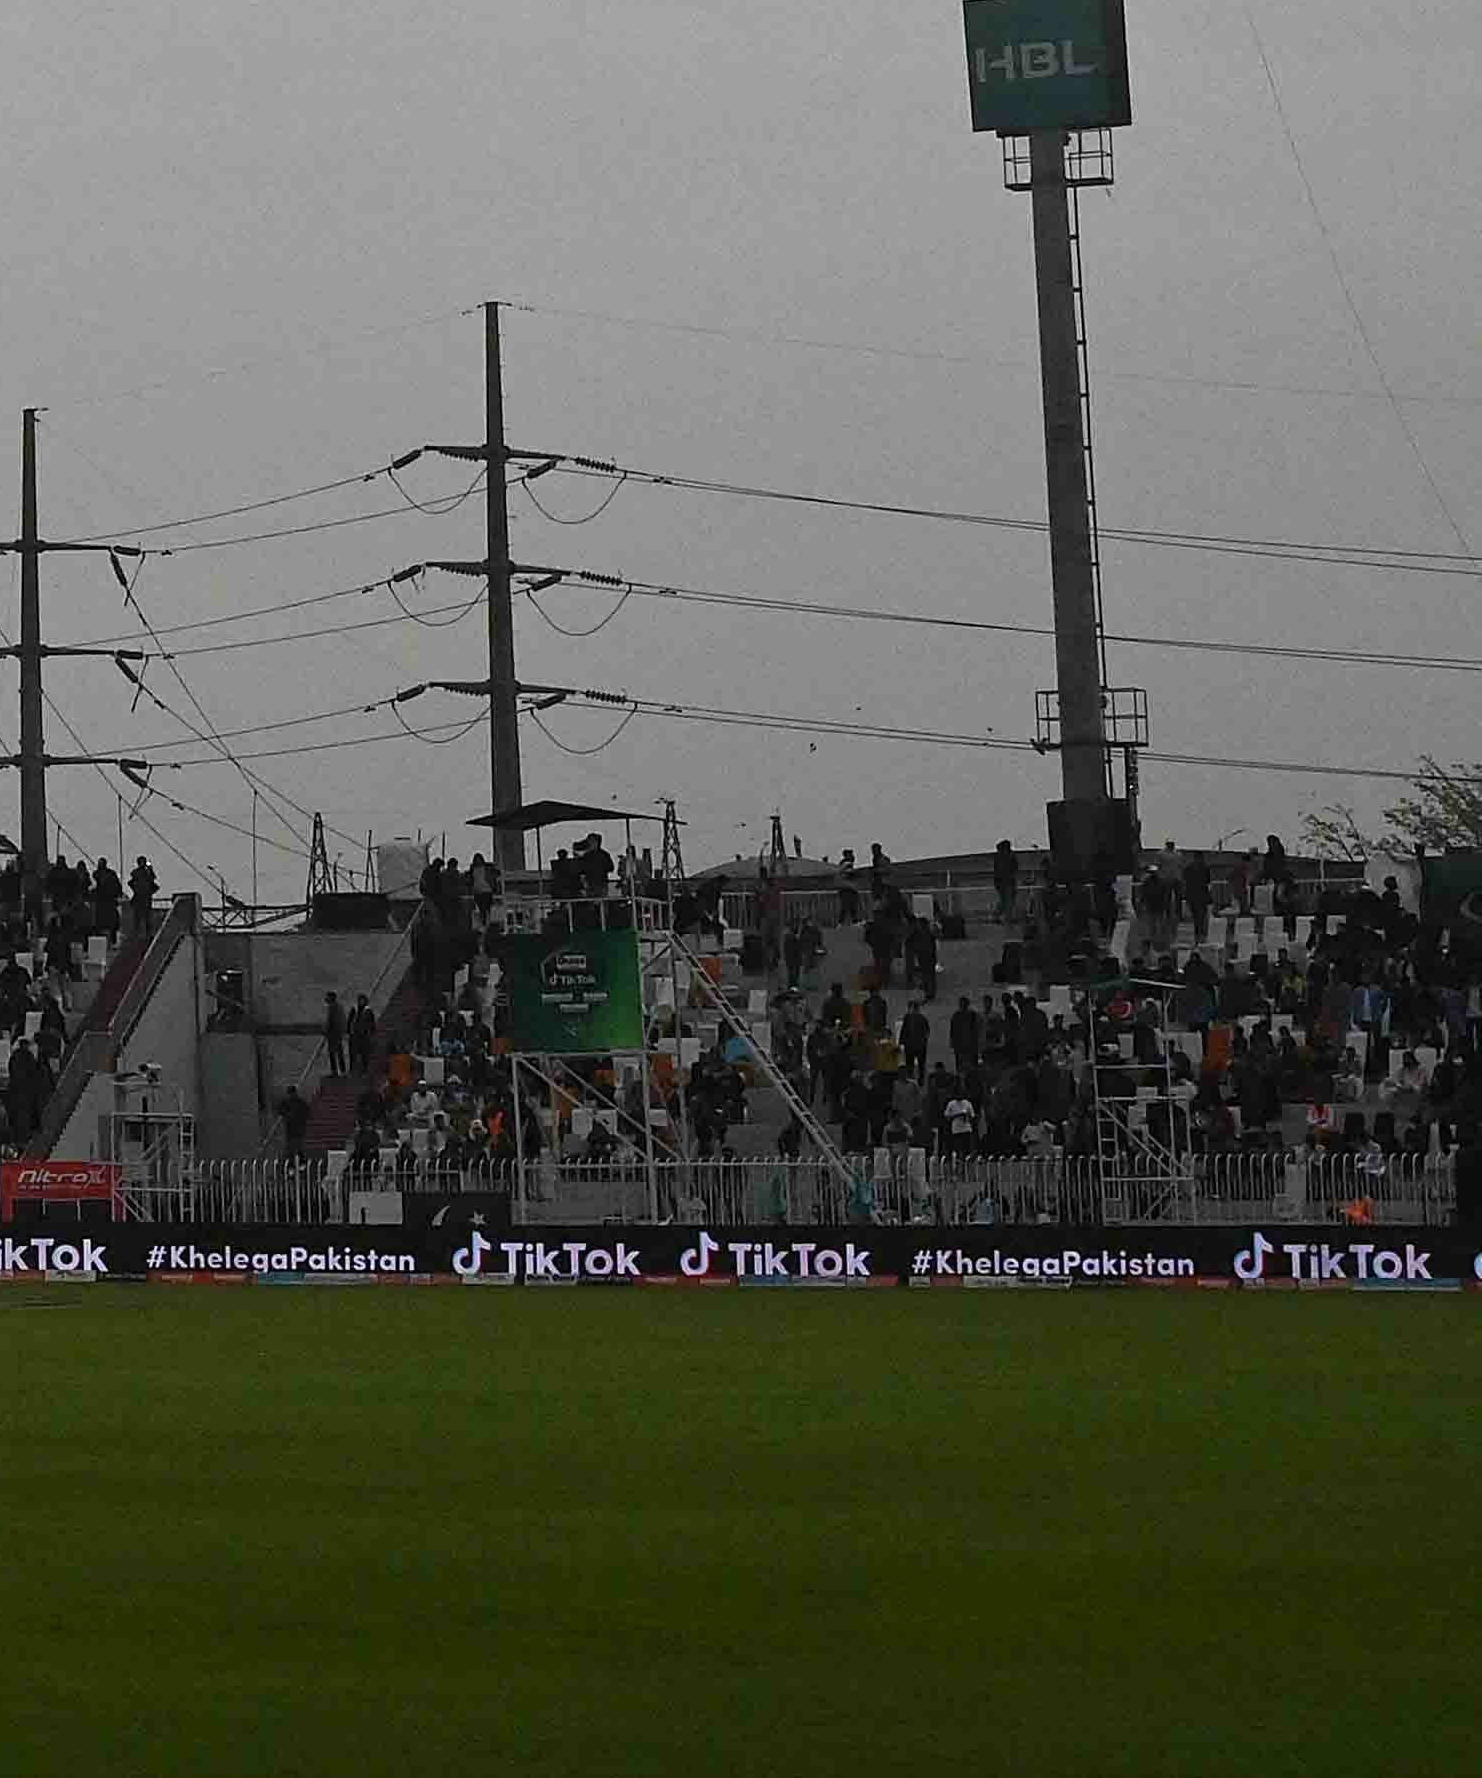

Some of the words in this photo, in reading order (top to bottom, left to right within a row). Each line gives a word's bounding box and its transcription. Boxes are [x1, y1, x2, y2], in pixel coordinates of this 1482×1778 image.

[974, 38, 1100, 83] HBL
[146, 1245, 416, 1275] #KhelegaPakistan
[501, 1242, 642, 1276] TikTok
[728, 1242, 871, 1277] TikTok
[911, 1249, 1195, 1279] #KhelegaPakistan
[1283, 1244, 1432, 1279] TikTok
